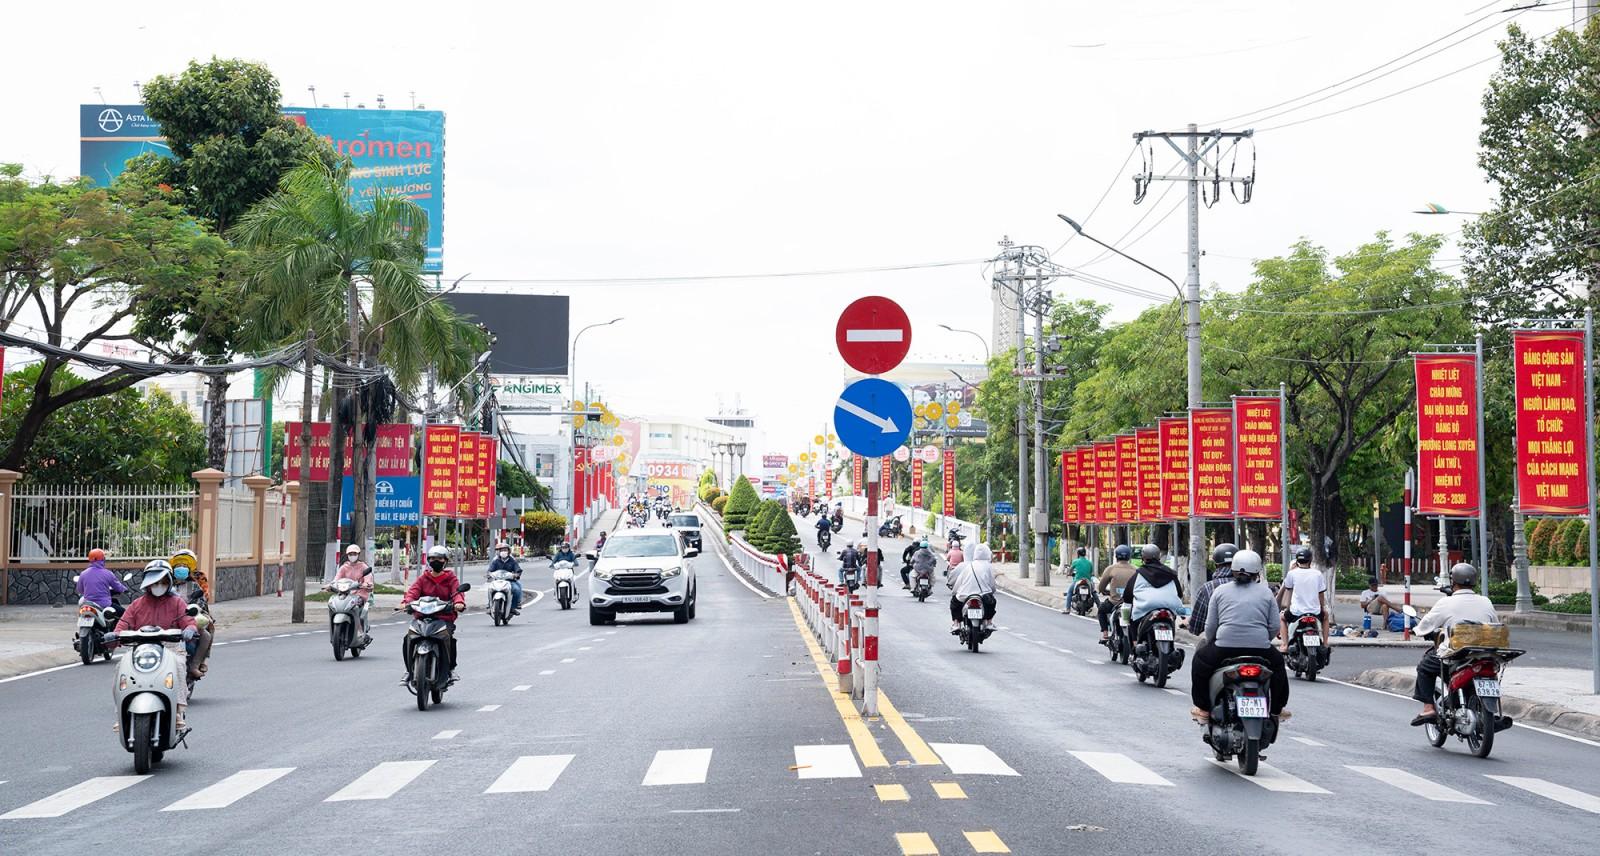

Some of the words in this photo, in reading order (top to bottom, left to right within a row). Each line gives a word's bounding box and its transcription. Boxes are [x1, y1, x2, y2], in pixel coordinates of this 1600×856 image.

[1531, 373, 1544, 389] VIỆT
[1546, 374, 1561, 386] NAM
[648, 465, 678, 477] 0934
[1121, 499, 1132, 509] 20
